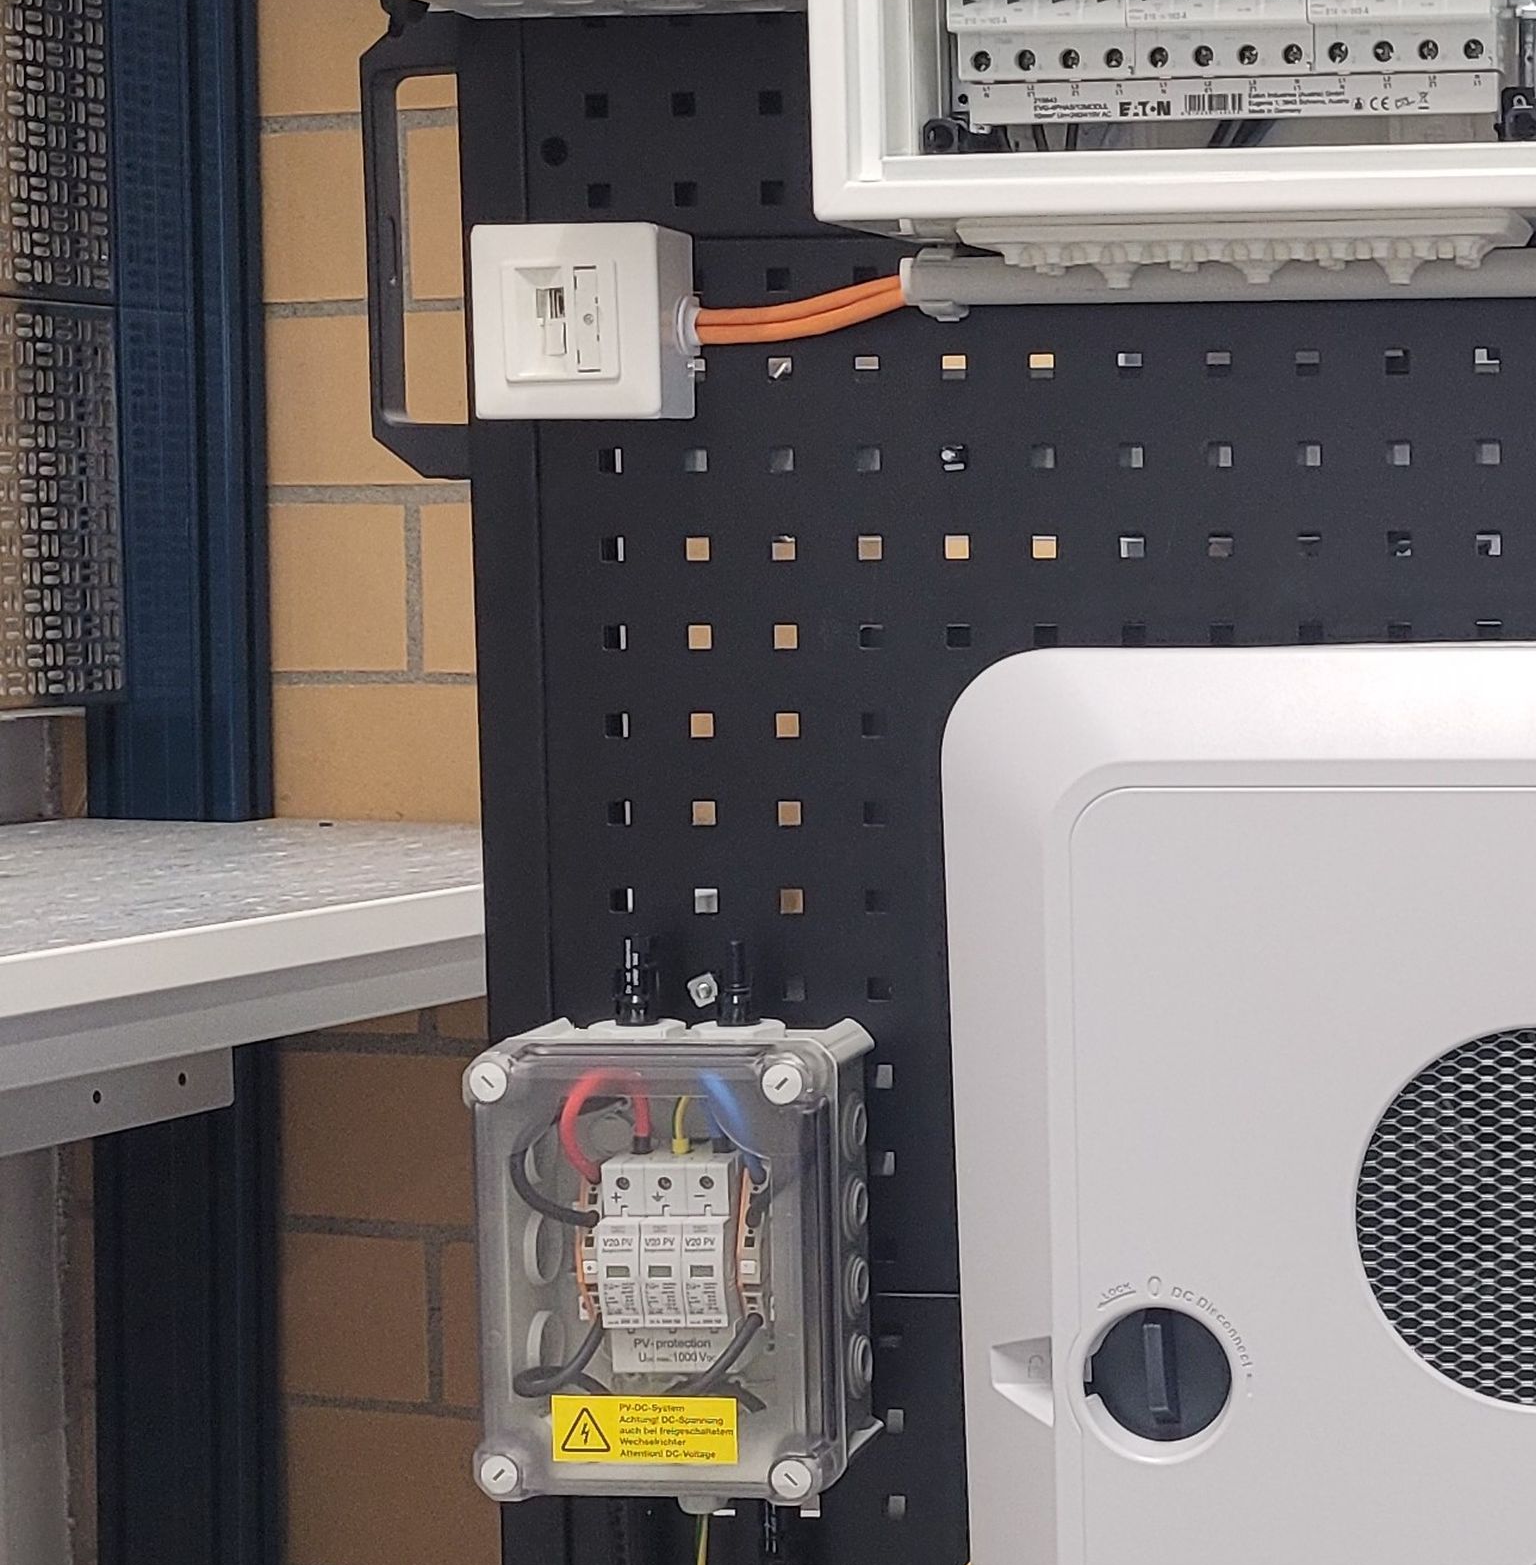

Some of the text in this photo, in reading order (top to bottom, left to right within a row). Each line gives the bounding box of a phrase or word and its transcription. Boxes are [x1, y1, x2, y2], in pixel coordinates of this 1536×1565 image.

[1119, 101, 1171, 117] EATON
[621, 1237, 633, 1246] PV
[663, 1237, 675, 1246] PV
[703, 1237, 716, 1246] PV
[1101, 1282, 1132, 1300] LOCK
[1171, 1286, 1195, 1302] DC
[619, 1403, 685, 1413] PV-DC-System
[661, 1416, 724, 1426] DC-Spannung
[619, 1426, 641, 1435] auch
[643, 1426, 658, 1435] bei
[619, 1437, 687, 1446] Wechselrichter
[665, 1449, 717, 1460] DC-Voltage
